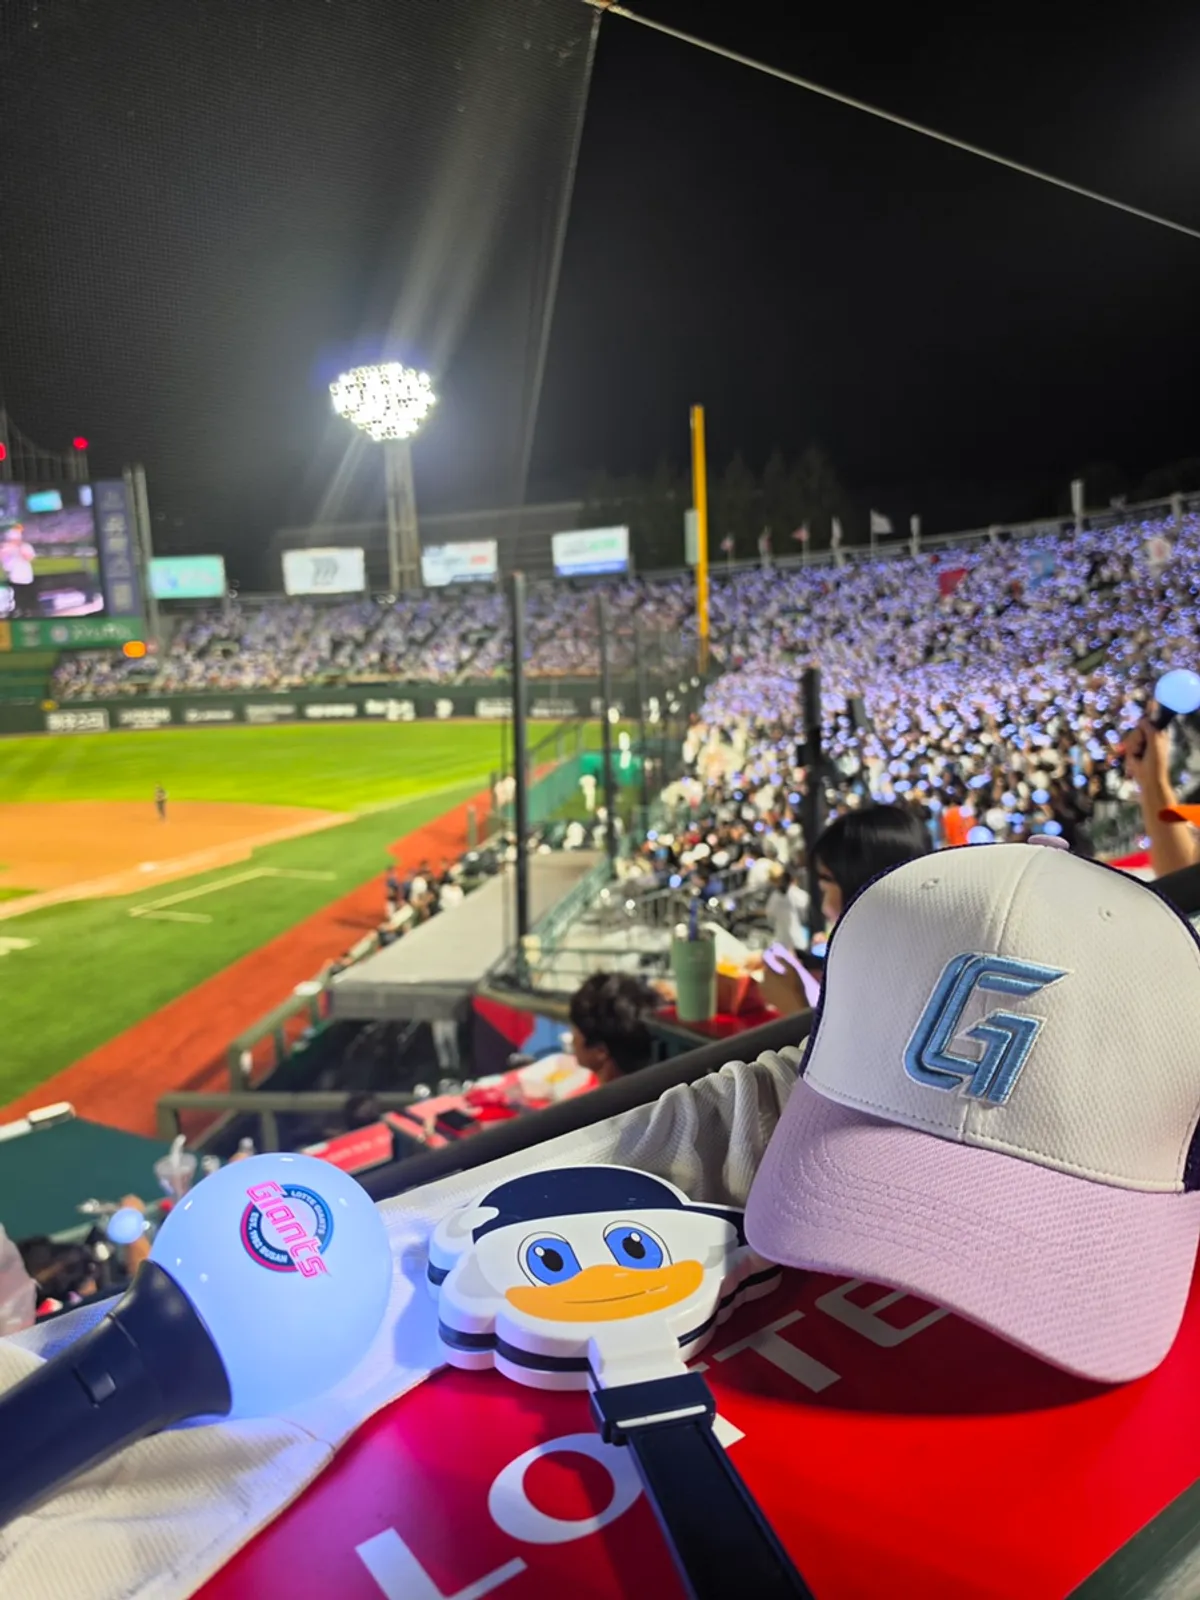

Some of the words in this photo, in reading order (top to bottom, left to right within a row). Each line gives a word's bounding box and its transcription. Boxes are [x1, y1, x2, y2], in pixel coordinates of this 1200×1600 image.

[902, 951, 1074, 1107] G
[258, 1245, 289, 1264] BUSAN
[291, 1190, 317, 1206] LOTTE
[314, 1203, 327, 1236] GIANTS
[355, 1278, 950, 1600] LOTE
